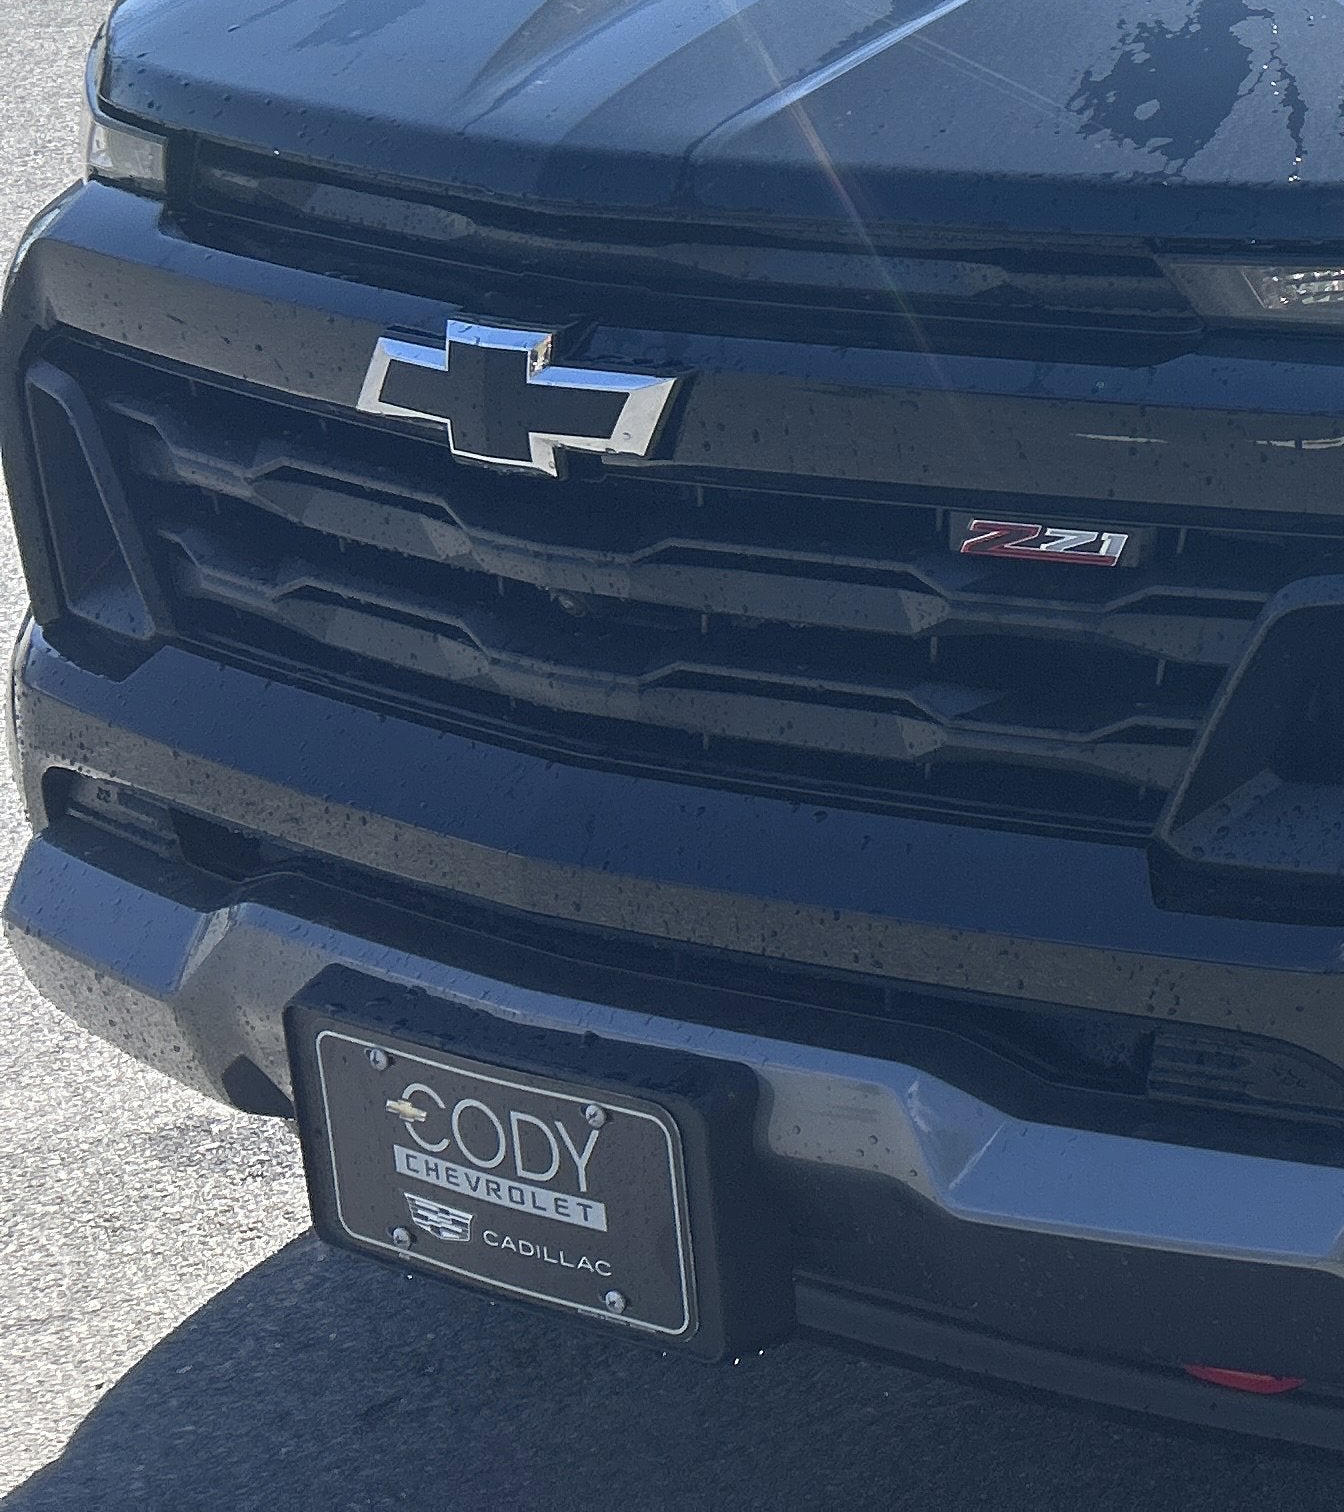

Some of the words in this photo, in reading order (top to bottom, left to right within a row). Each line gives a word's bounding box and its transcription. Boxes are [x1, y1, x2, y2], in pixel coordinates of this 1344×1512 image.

[960, 519, 1129, 567] Z71
[400, 1082, 600, 1193] CODY
[404, 1152, 594, 1222] CHEVROLET
[482, 1229, 613, 1277] CADILLAC
